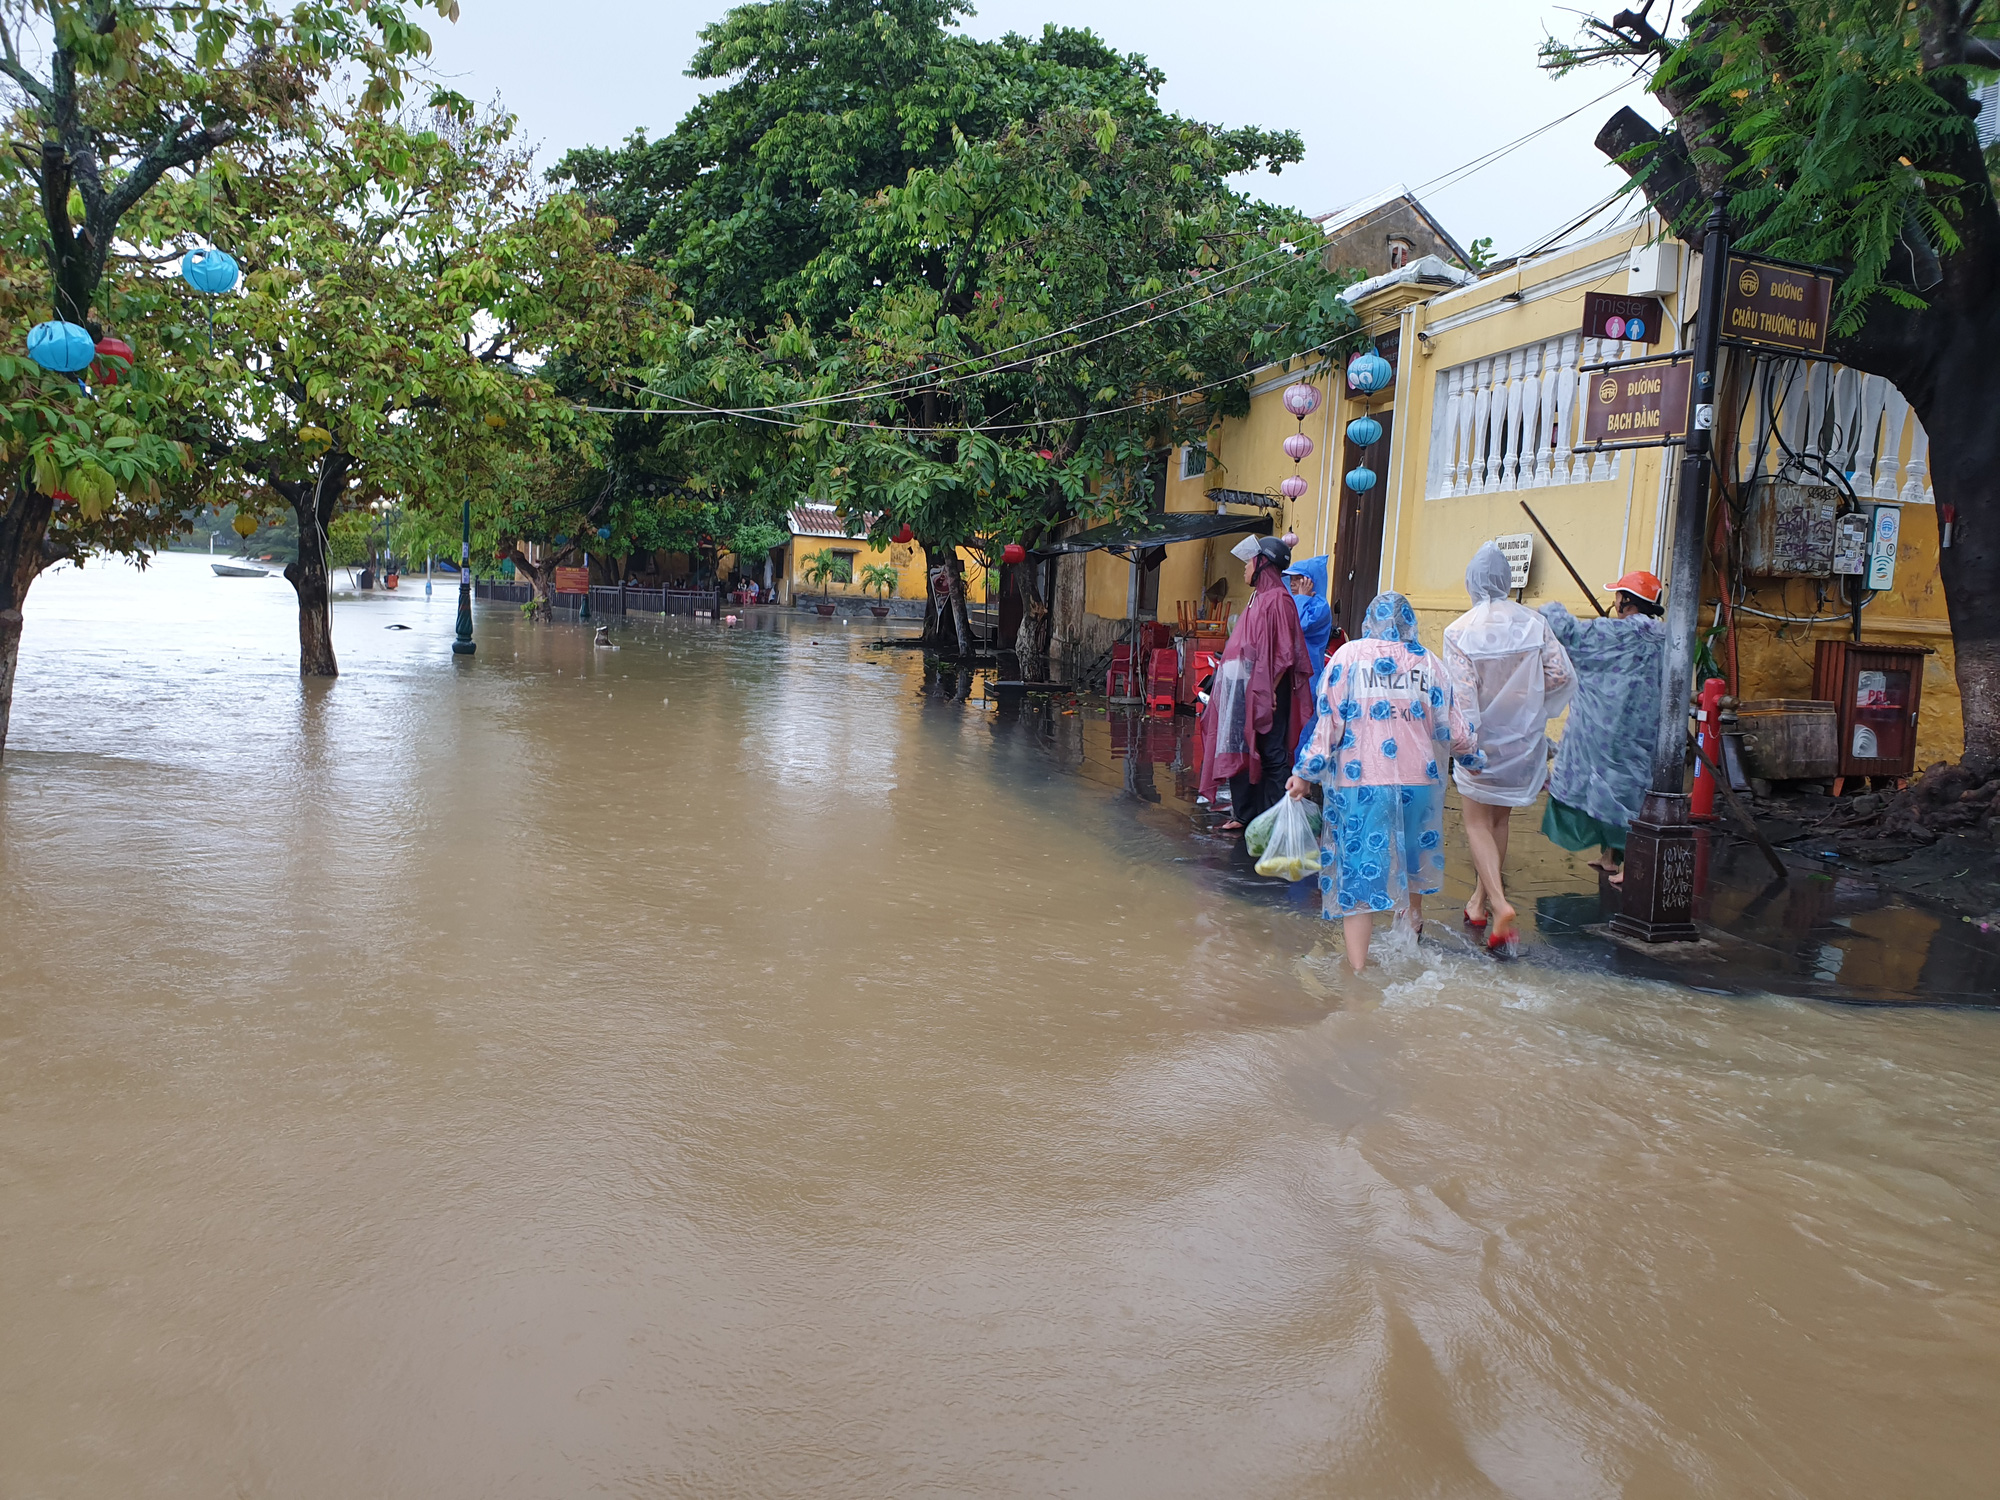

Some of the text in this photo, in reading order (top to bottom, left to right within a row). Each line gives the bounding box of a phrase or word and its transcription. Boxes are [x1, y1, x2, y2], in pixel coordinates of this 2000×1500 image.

[1770, 279, 1804, 302] ĐƯỜNG
[1594, 296, 1648, 317] mister
[1760, 312, 1797, 337] THƯỢNG
[1798, 318, 1817, 340] VĂN
[1627, 374, 1661, 396] ĐƯỜNG
[1607, 405, 1660, 433] BẠCH ĐẰNG
